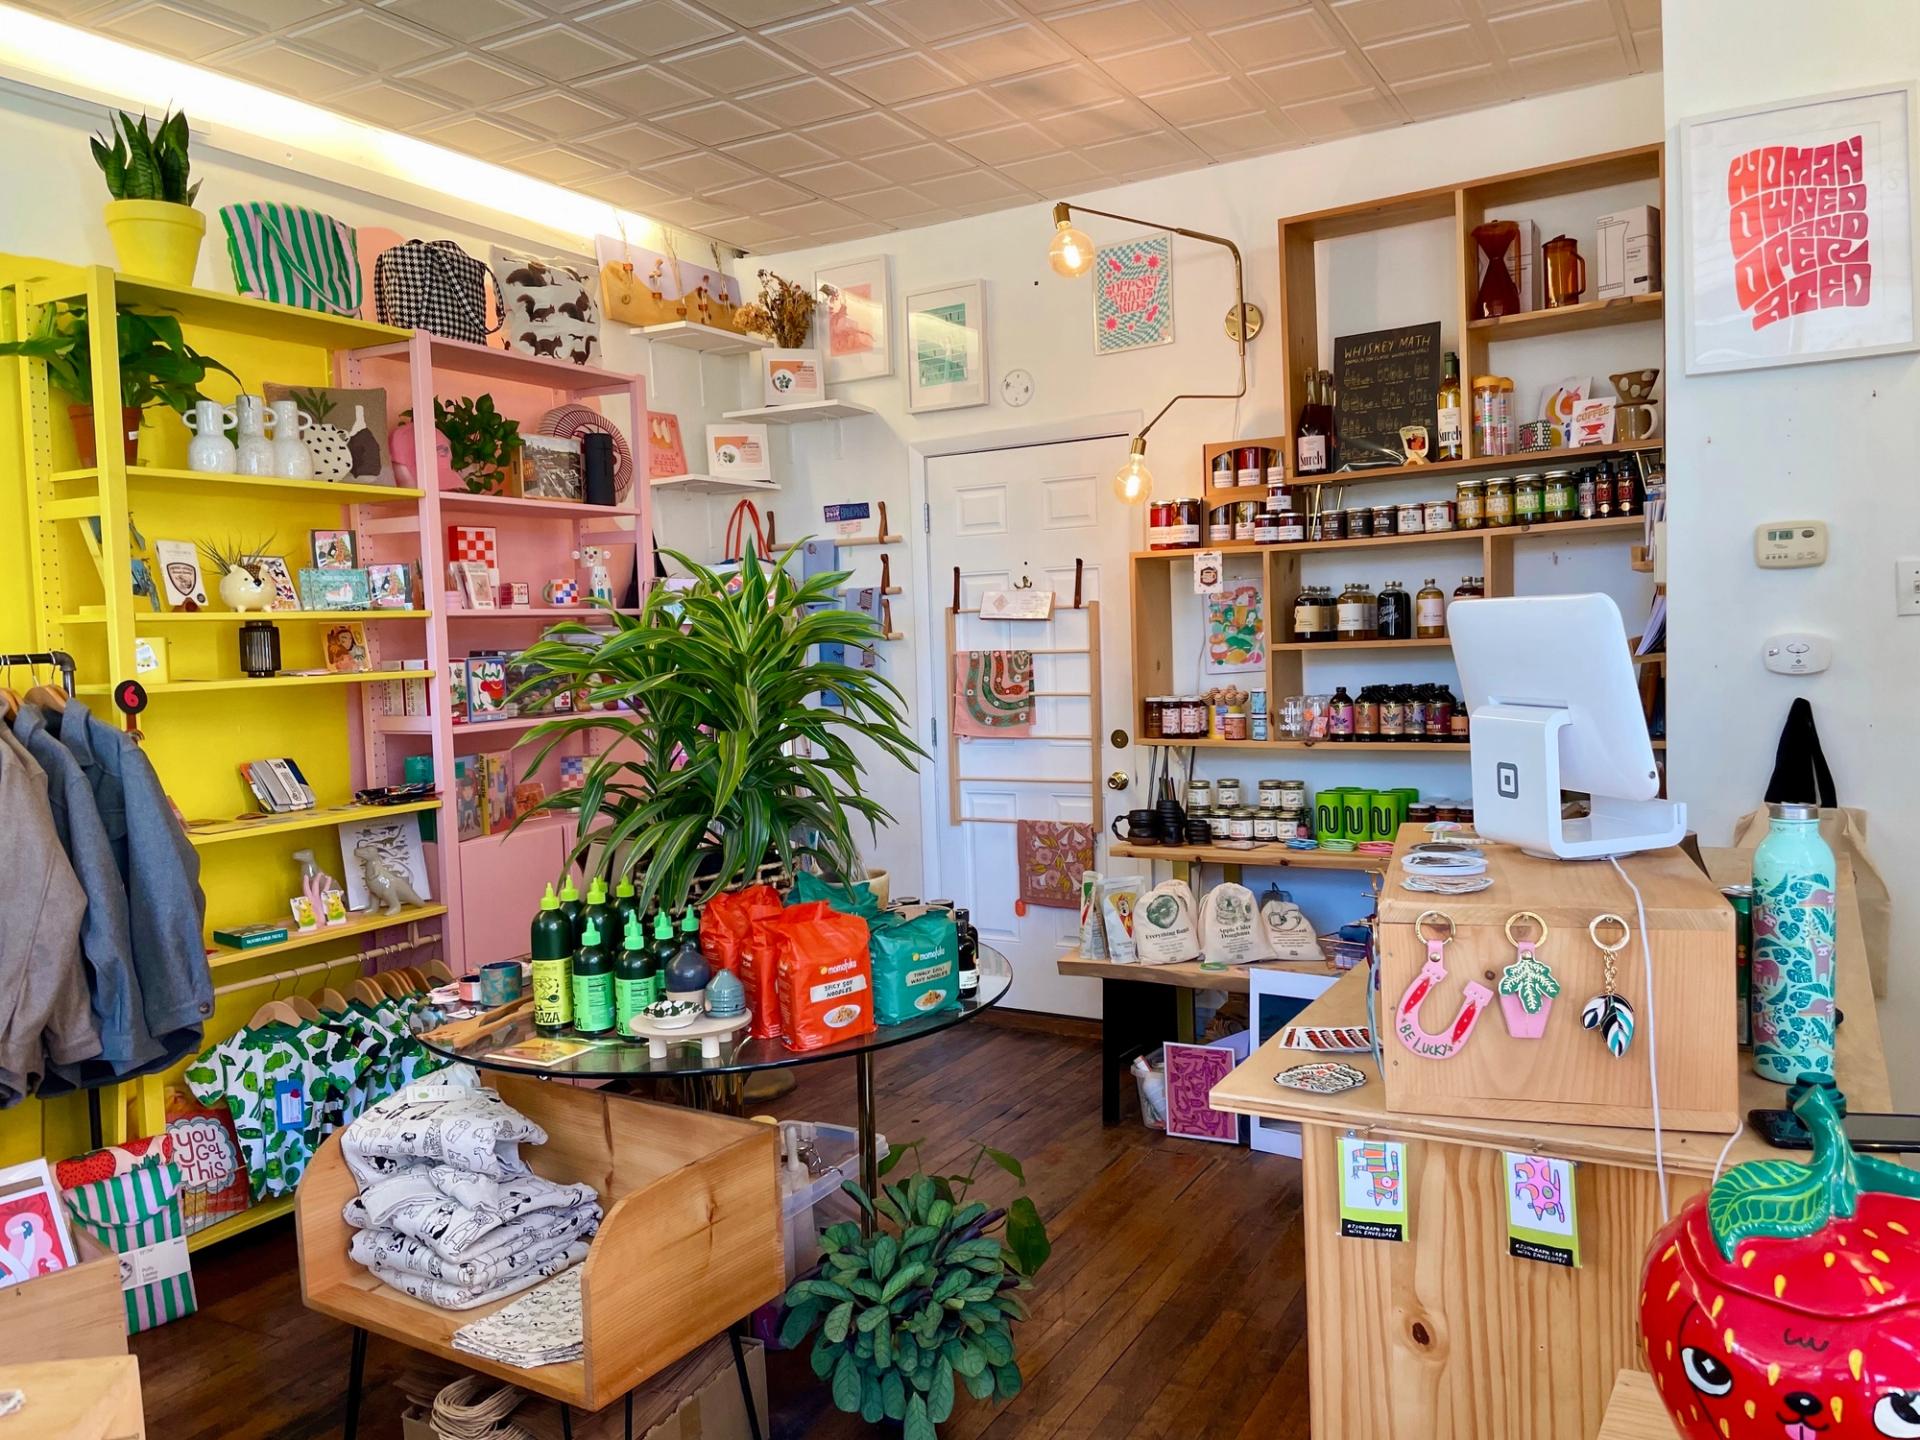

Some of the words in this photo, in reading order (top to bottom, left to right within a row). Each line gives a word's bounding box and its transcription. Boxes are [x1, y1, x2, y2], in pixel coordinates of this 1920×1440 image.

[1728, 135, 1863, 206] WOMAN
[1730, 183, 1867, 261] OWNED
[1789, 212, 1869, 240] AND
[1735, 229, 1869, 311] OPER
[1105, 275, 1159, 298] SUPPORT
[1113, 287, 1154, 305] TRANS
[1119, 300, 1147, 314] KIDS
[1751, 264, 1872, 331] ATED
[1344, 340, 1394, 358] WHISKEY
[1399, 335, 1431, 348] MATH
[1576, 405, 1610, 422] COFFEE
[1439, 425, 1461, 443] Surely
[1300, 450, 1324, 470] Surely
[124, 685, 139, 707] 6
[1145, 930, 1176, 940] Everything
[919, 946, 945, 961] momofuku
[827, 958, 857, 975] momofuku
[927, 970, 948, 981] NOODLES
[824, 981, 841, 991] SPICY
[842, 979, 854, 988] SOY
[826, 986, 853, 998] NOODLES
[1400, 1023, 1416, 1042] BE
[1412, 1036, 1448, 1057] LUCKY
[196, 1143, 226, 1161] Got
[182, 1161, 228, 1182] This
